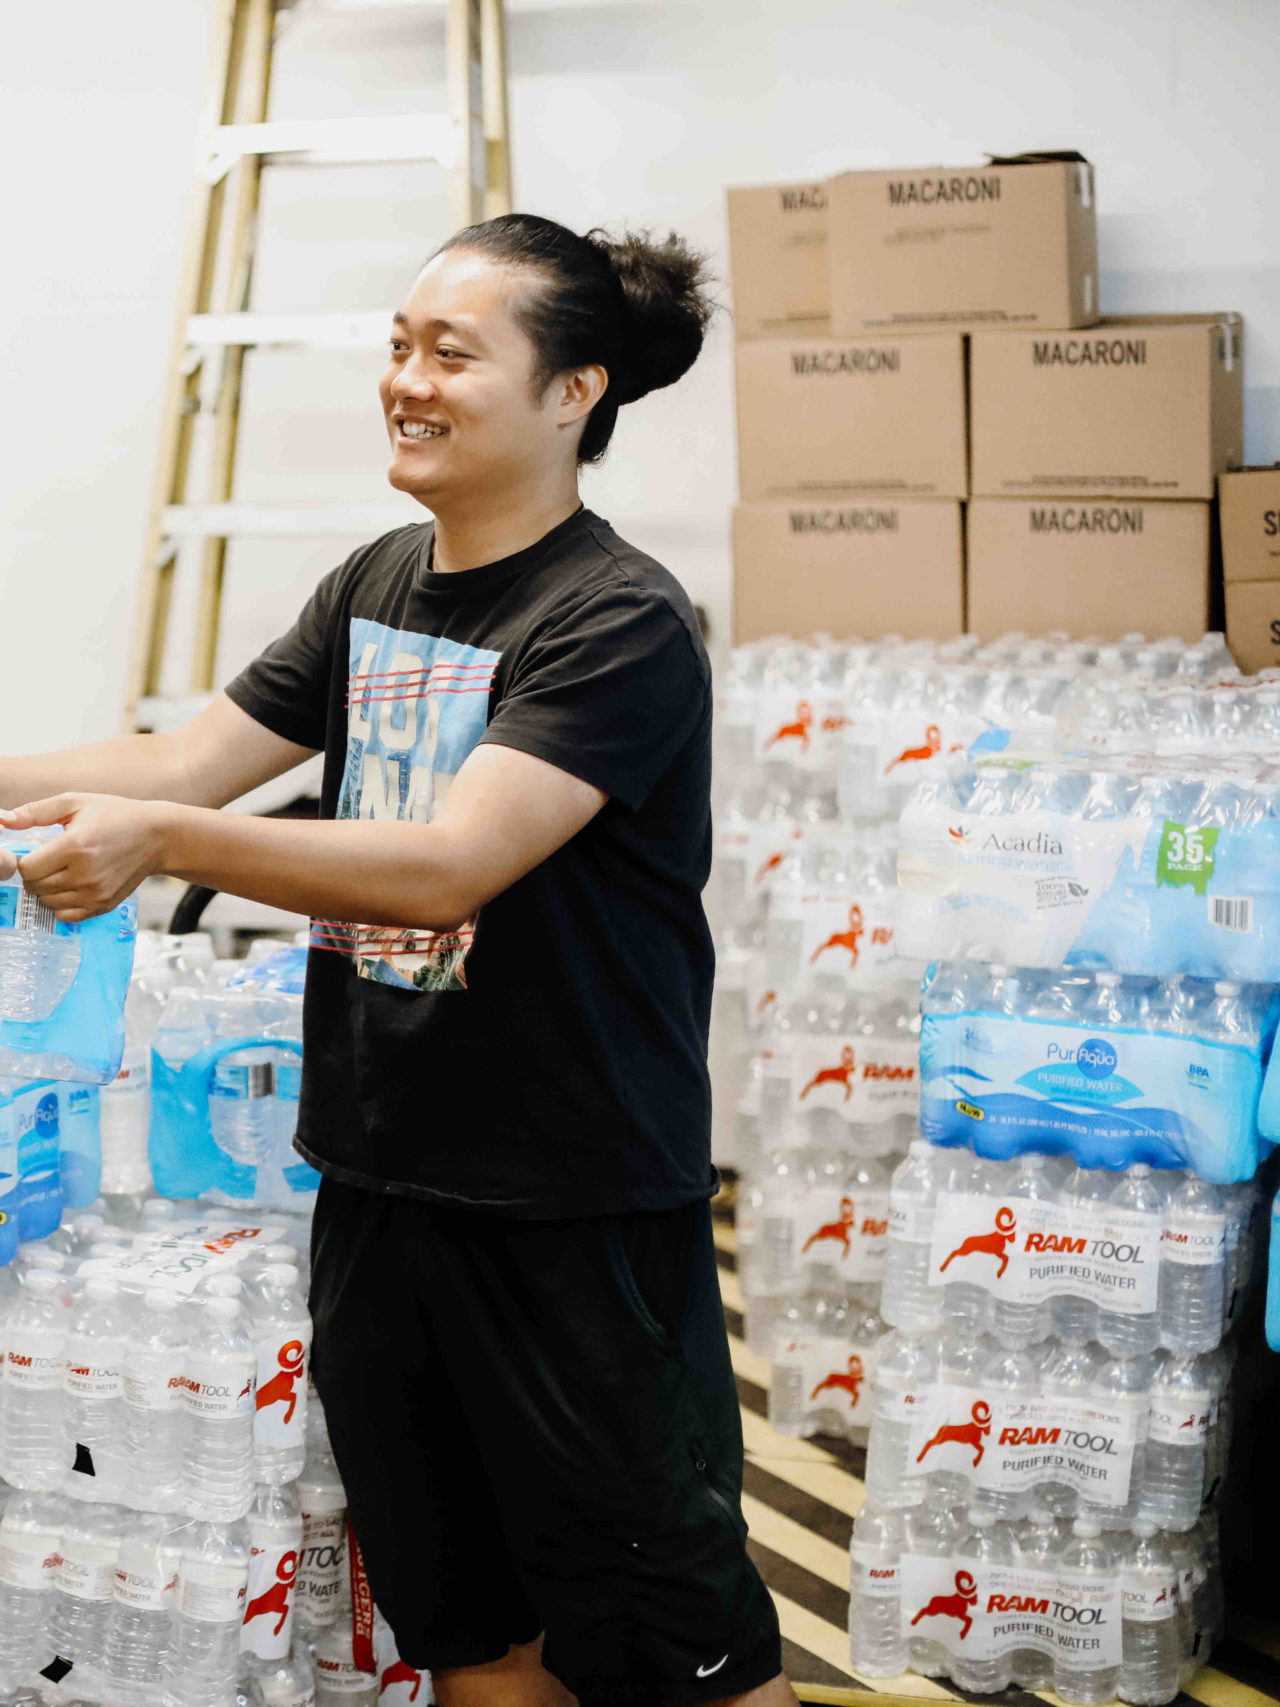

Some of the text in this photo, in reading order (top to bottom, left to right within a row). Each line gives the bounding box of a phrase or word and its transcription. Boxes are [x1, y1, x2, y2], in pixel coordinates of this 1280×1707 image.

[888, 176, 1001, 206] MACARONI
[791, 349, 901, 375] MACARONI
[1033, 340, 1147, 365] MACARONI
[790, 508, 899, 533] MACARONI
[1029, 508, 1143, 534] MACARONI
[982, 832, 1063, 855] Acadia
[1167, 830, 1204, 864] 35
[1167, 863, 1204, 871] PACK
[1038, 1073, 1123, 1092] PURIFIED WATER
[1189, 1064, 1209, 1078] BPA
[1024, 1233, 1145, 1264] RAM TOOL
[1029, 1264, 1137, 1290] PURIFIED WATER
[8, 1352, 33, 1368] RAM
[201, 1384, 232, 1398] TOOL
[204, 1402, 228, 1412] WATER
[998, 1427, 1118, 1456] RAM TOOL
[1002, 1455, 1108, 1481] PURIFIED WATER
[129, 1574, 156, 1589] TOOL
[309, 1579, 343, 1597] WATE
[986, 1594, 1107, 1626] RAM TOOL
[993, 1622, 1100, 1650] PURIFIED WATER
